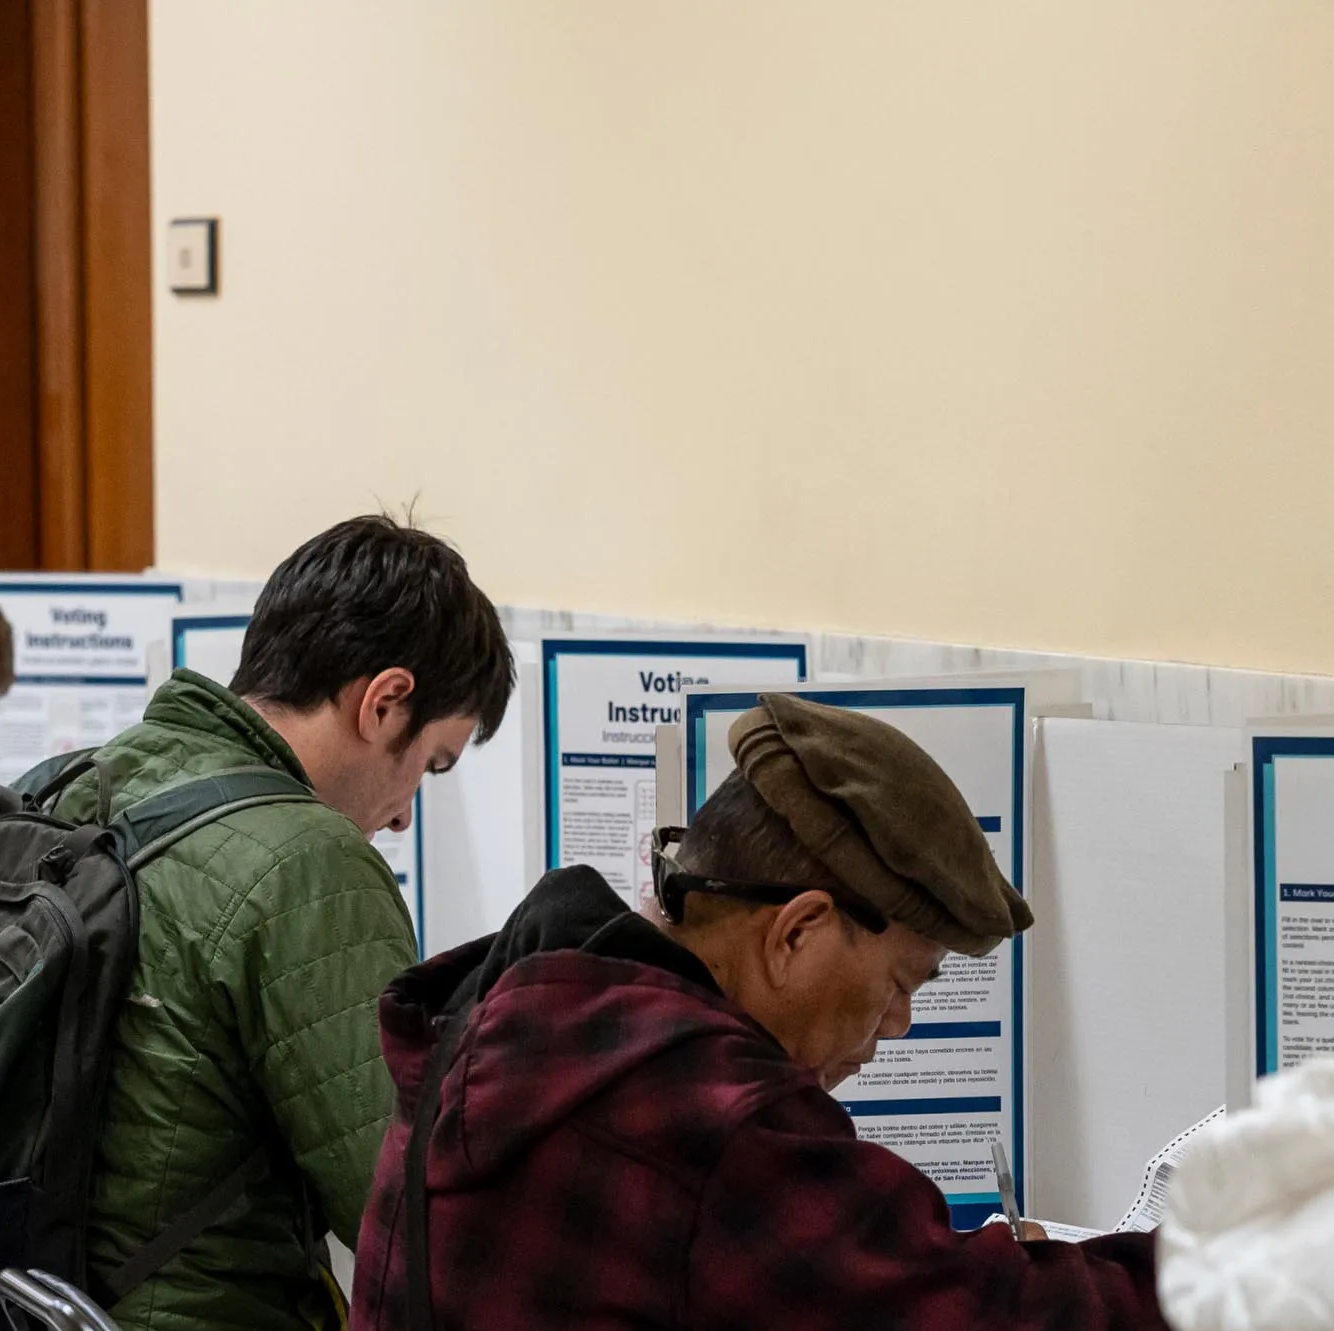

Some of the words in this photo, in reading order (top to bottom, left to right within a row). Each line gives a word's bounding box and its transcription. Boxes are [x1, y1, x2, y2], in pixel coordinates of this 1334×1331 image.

[49, 606, 107, 631] Voting
[26, 632, 134, 650] Instructions
[1292, 889, 1315, 898] Mark
